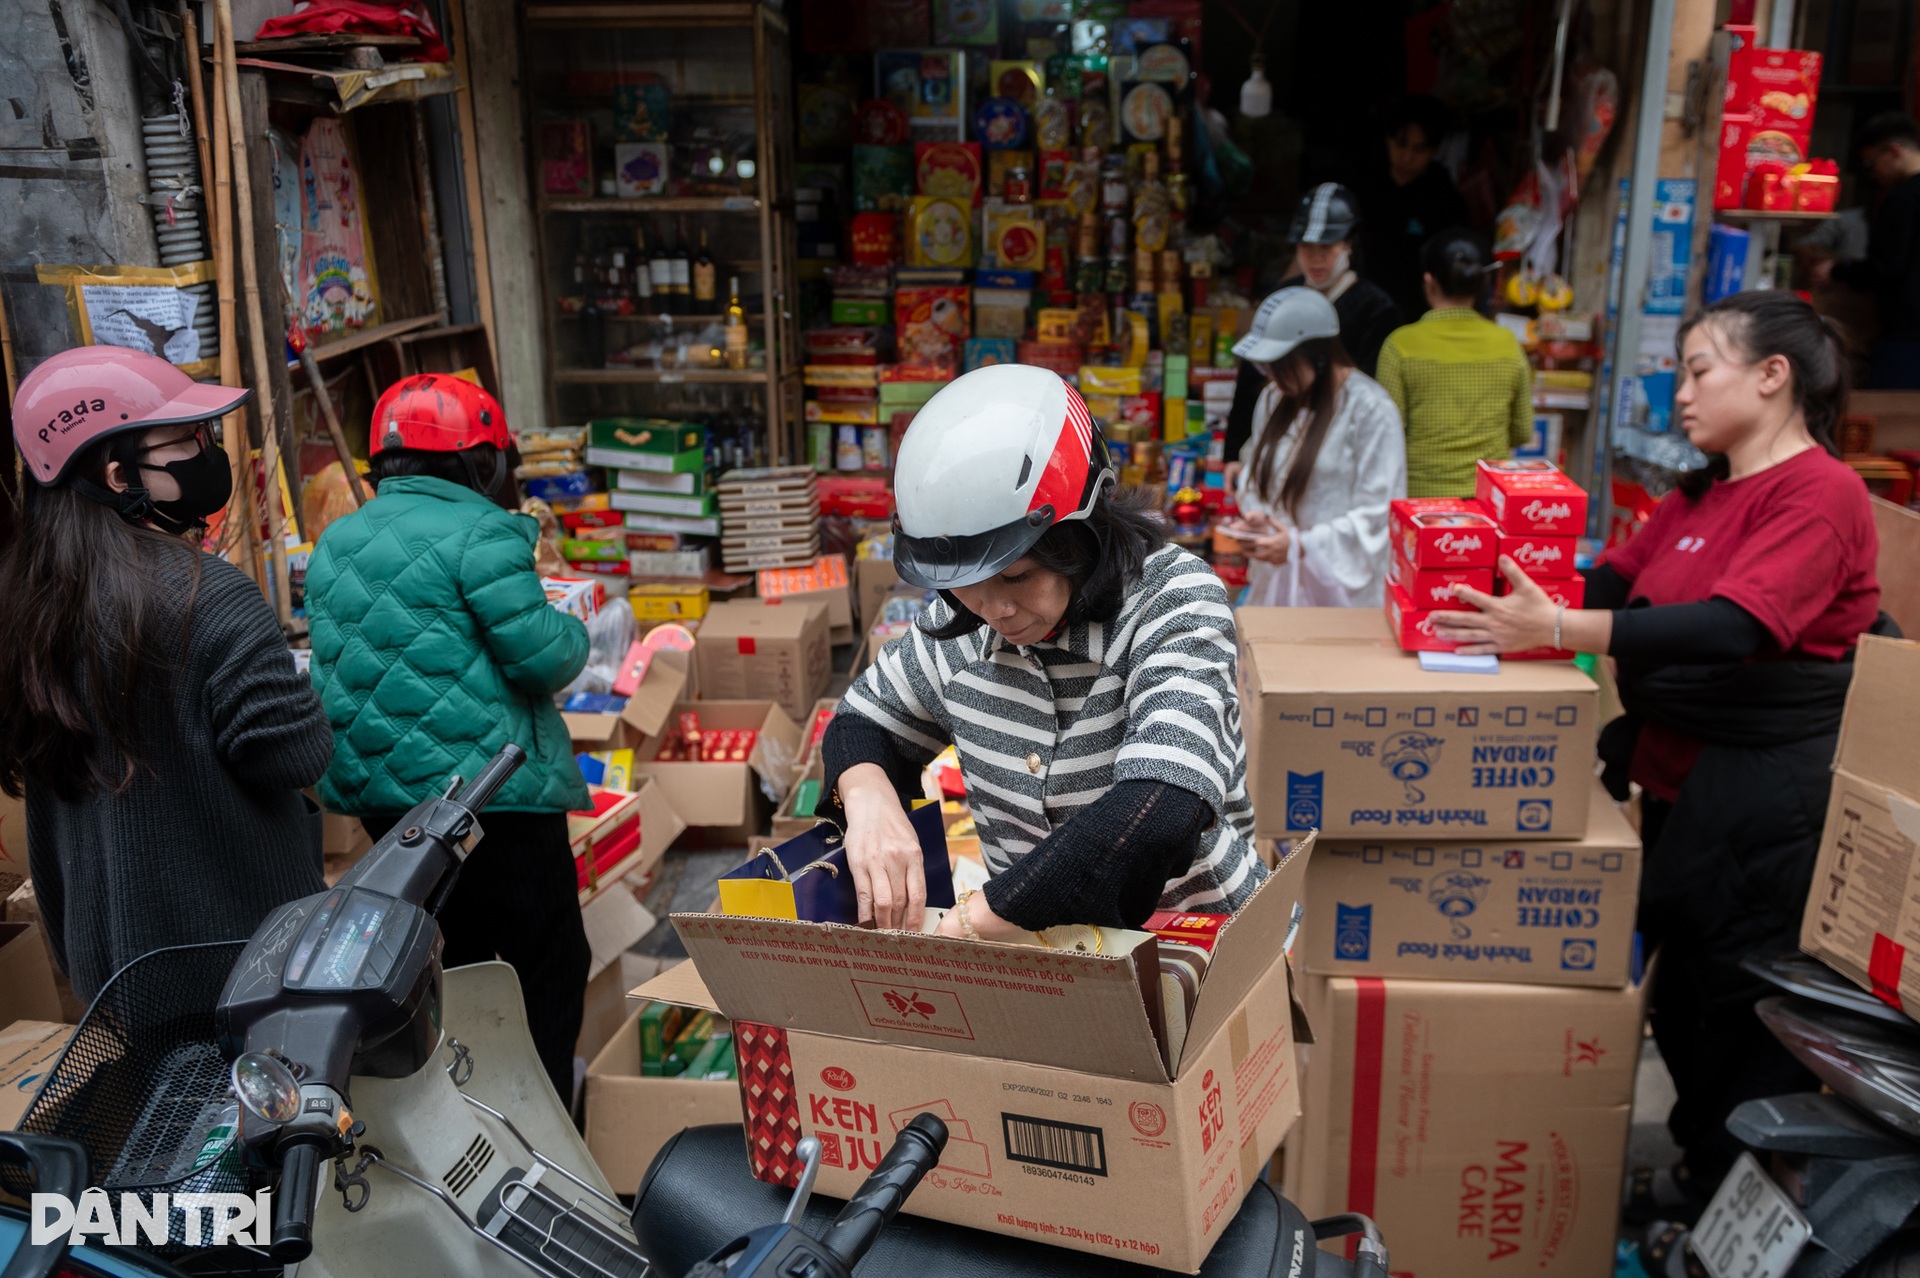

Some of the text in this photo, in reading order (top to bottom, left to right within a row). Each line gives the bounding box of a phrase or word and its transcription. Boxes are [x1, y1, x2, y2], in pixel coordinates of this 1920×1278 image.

[60, 417, 86, 434] Helmet
[1521, 500, 1571, 523] English
[1434, 532, 1482, 555] English
[1513, 542, 1562, 566] English
[1472, 745, 1558, 763] JORDAN
[1471, 766, 1555, 788] COFFEE
[1350, 809, 1392, 825] Food
[1437, 809, 1488, 827] Thành
[1517, 886, 1602, 905] JORDAN
[1516, 906, 1599, 929] COFFEE
[780, 940, 798, 950] KHÔ
[799, 941, 819, 953] RÁO,
[818, 944, 853, 956] THOÁNG
[873, 950, 903, 961] TRÁNH
[923, 955, 950, 967] NẮNG
[949, 960, 974, 972] TRỰC
[974, 961, 994, 973] TIẾP
[995, 964, 1009, 976] VÀ
[1009, 967, 1037, 980] NHIỆT
[1039, 970, 1054, 982] ĐỘ
[1055, 973, 1075, 983] CAO
[1397, 941, 1438, 959] Food
[740, 951, 760, 960] KEEP
[761, 952, 770, 960] IN
[771, 953, 777, 961] A
[778, 954, 799, 964] COOL
[799, 956, 806, 965] &
[806, 957, 823, 966] DRY
[852, 962, 878, 972] AVOID
[878, 964, 909, 976] DIRECT
[909, 968, 953, 982] SUNLIGHT
[954, 974, 973, 984] AND
[973, 977, 998, 988] HIGH
[997, 980, 1066, 997] TEMPERATURE
[1058, 1092, 1068, 1100] G2
[1199, 1081, 1222, 1127] KEN
[809, 1092, 878, 1134] KEN
[1210, 1107, 1224, 1143] JU
[845, 1136, 882, 1171] JU
[1022, 1165, 1095, 1186] 18936047440143
[1457, 1165, 1487, 1239] CAKE
[1487, 1140, 1530, 1261] MARIA
[1558, 1177, 1573, 1210] BEST
[1016, 1217, 1038, 1232] lượng
[1039, 1222, 1058, 1235] tịnh:
[1060, 1225, 1083, 1239] 2.304
[1084, 1231, 1095, 1244] kg
[1096, 1232, 1113, 1245] (192
[1115, 1238, 1121, 1249] g
[1128, 1239, 1139, 1251] 12
[1140, 1241, 1161, 1256] hộp)
